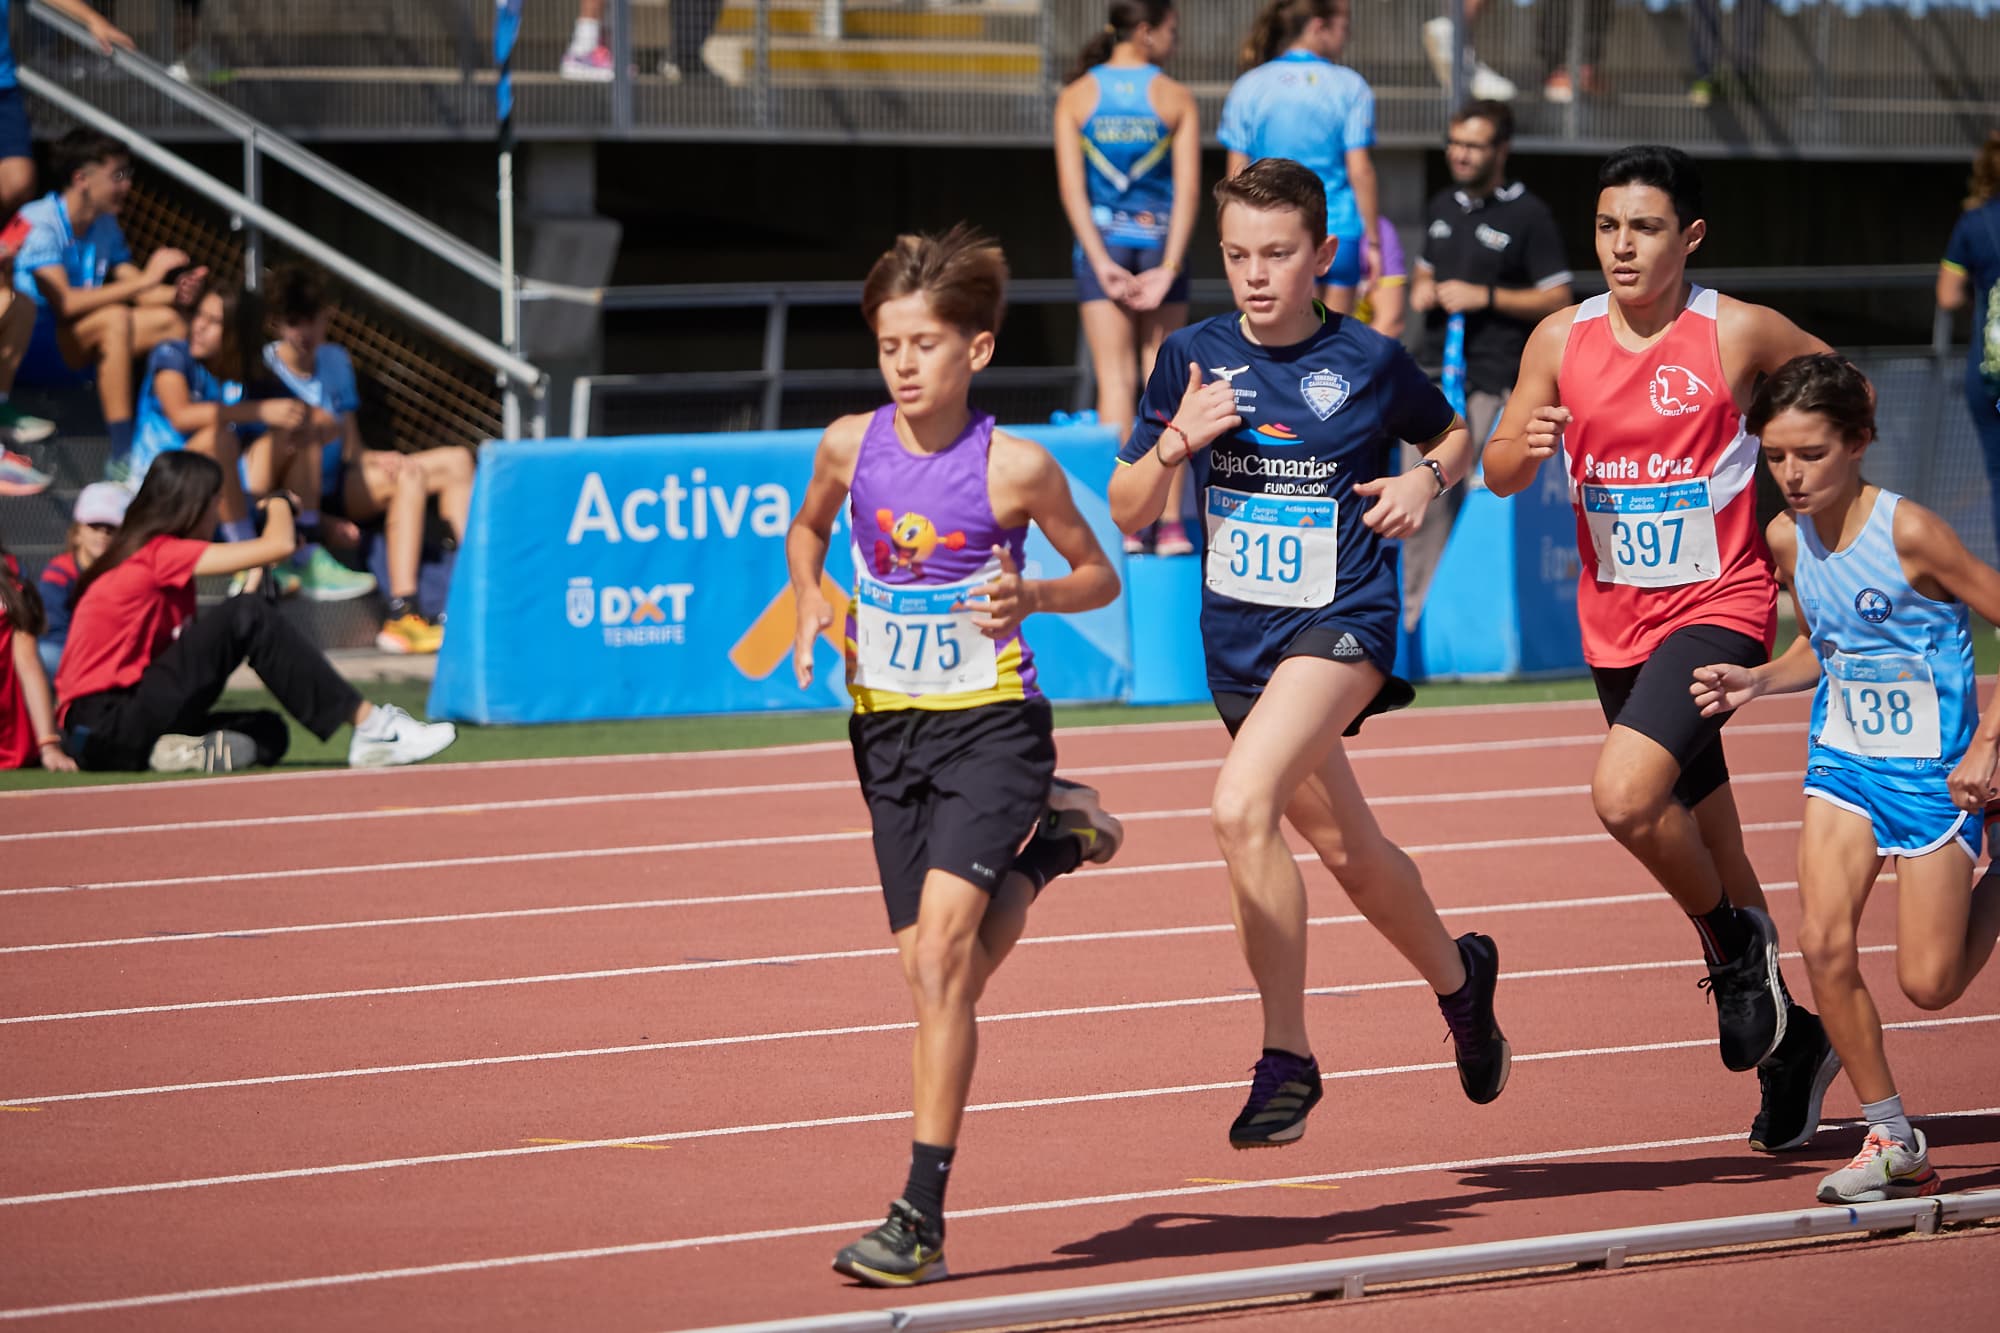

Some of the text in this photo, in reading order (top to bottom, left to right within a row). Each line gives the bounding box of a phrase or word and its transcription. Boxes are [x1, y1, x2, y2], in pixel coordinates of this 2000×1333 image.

[1210, 449, 1338, 478] CajaCanarias
[1585, 453, 1694, 479] Santa Cruz
[566, 467, 791, 544] Activa
[1264, 482, 1328, 495] FUNDACIÓN
[1230, 529, 1303, 584] 319
[1612, 518, 1684, 567] 397
[600, 584, 694, 626] DXT
[603, 624, 685, 647] TENERIFE
[885, 621, 961, 671] 275
[1333, 646, 1363, 656] adidas
